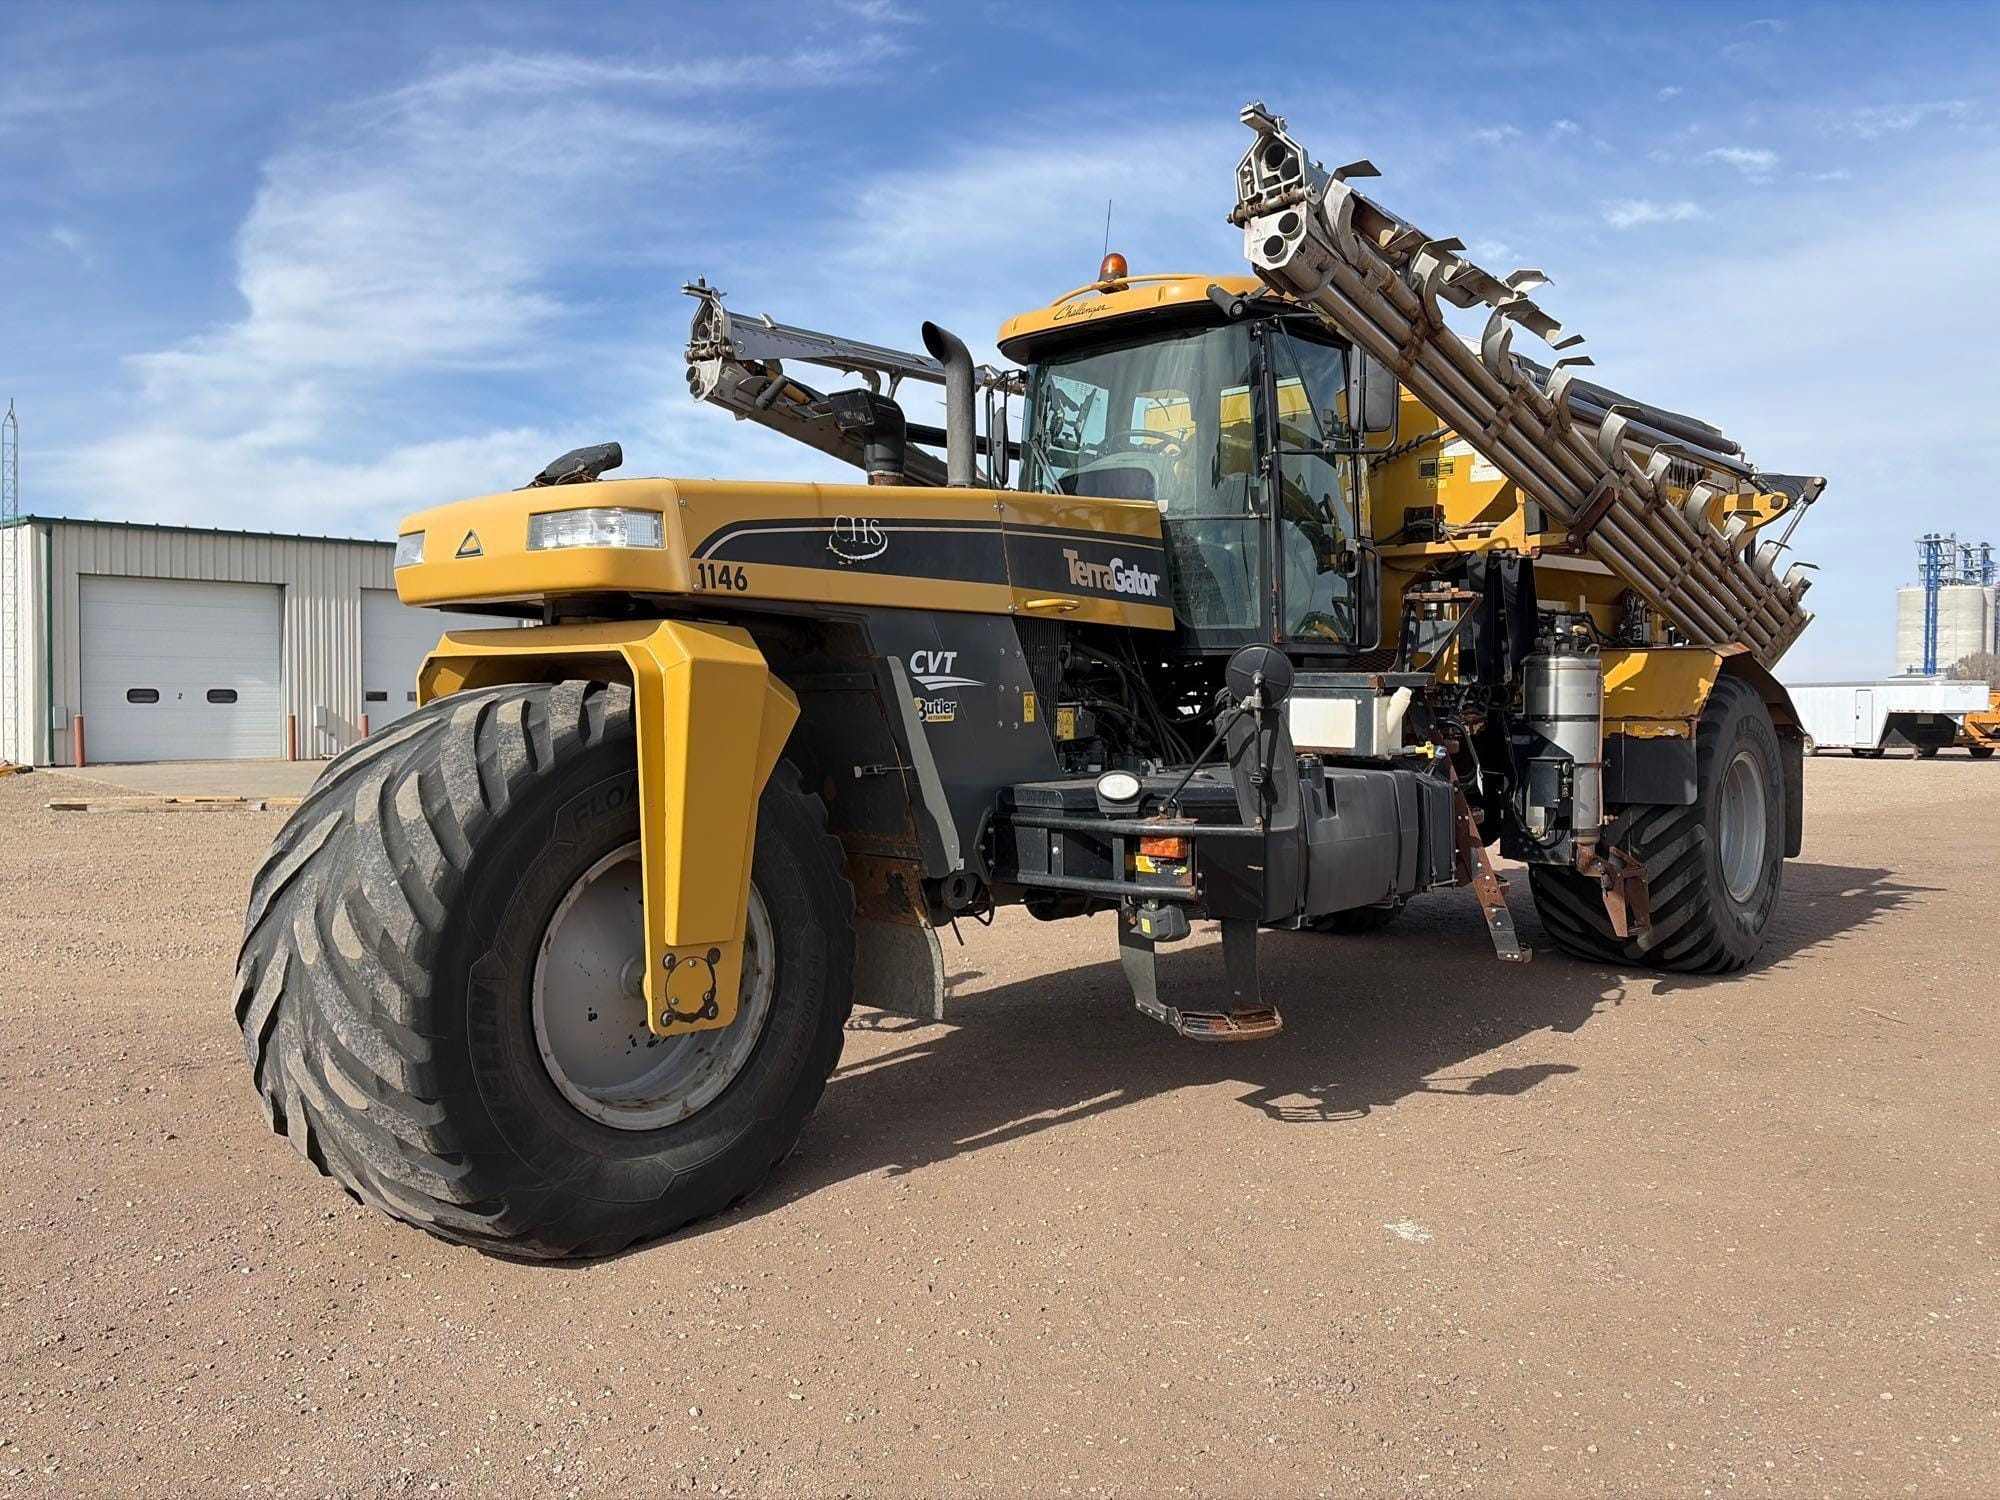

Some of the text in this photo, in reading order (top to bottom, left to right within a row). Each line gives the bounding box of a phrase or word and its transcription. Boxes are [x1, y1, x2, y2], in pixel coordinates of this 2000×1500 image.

[1053, 302, 1115, 321] Challenger
[833, 514, 883, 546] CHS
[697, 562, 748, 592] 1146
[1062, 547, 1159, 597] TerraGator
[909, 650, 957, 674] CVT
[914, 697, 956, 721] Butler
